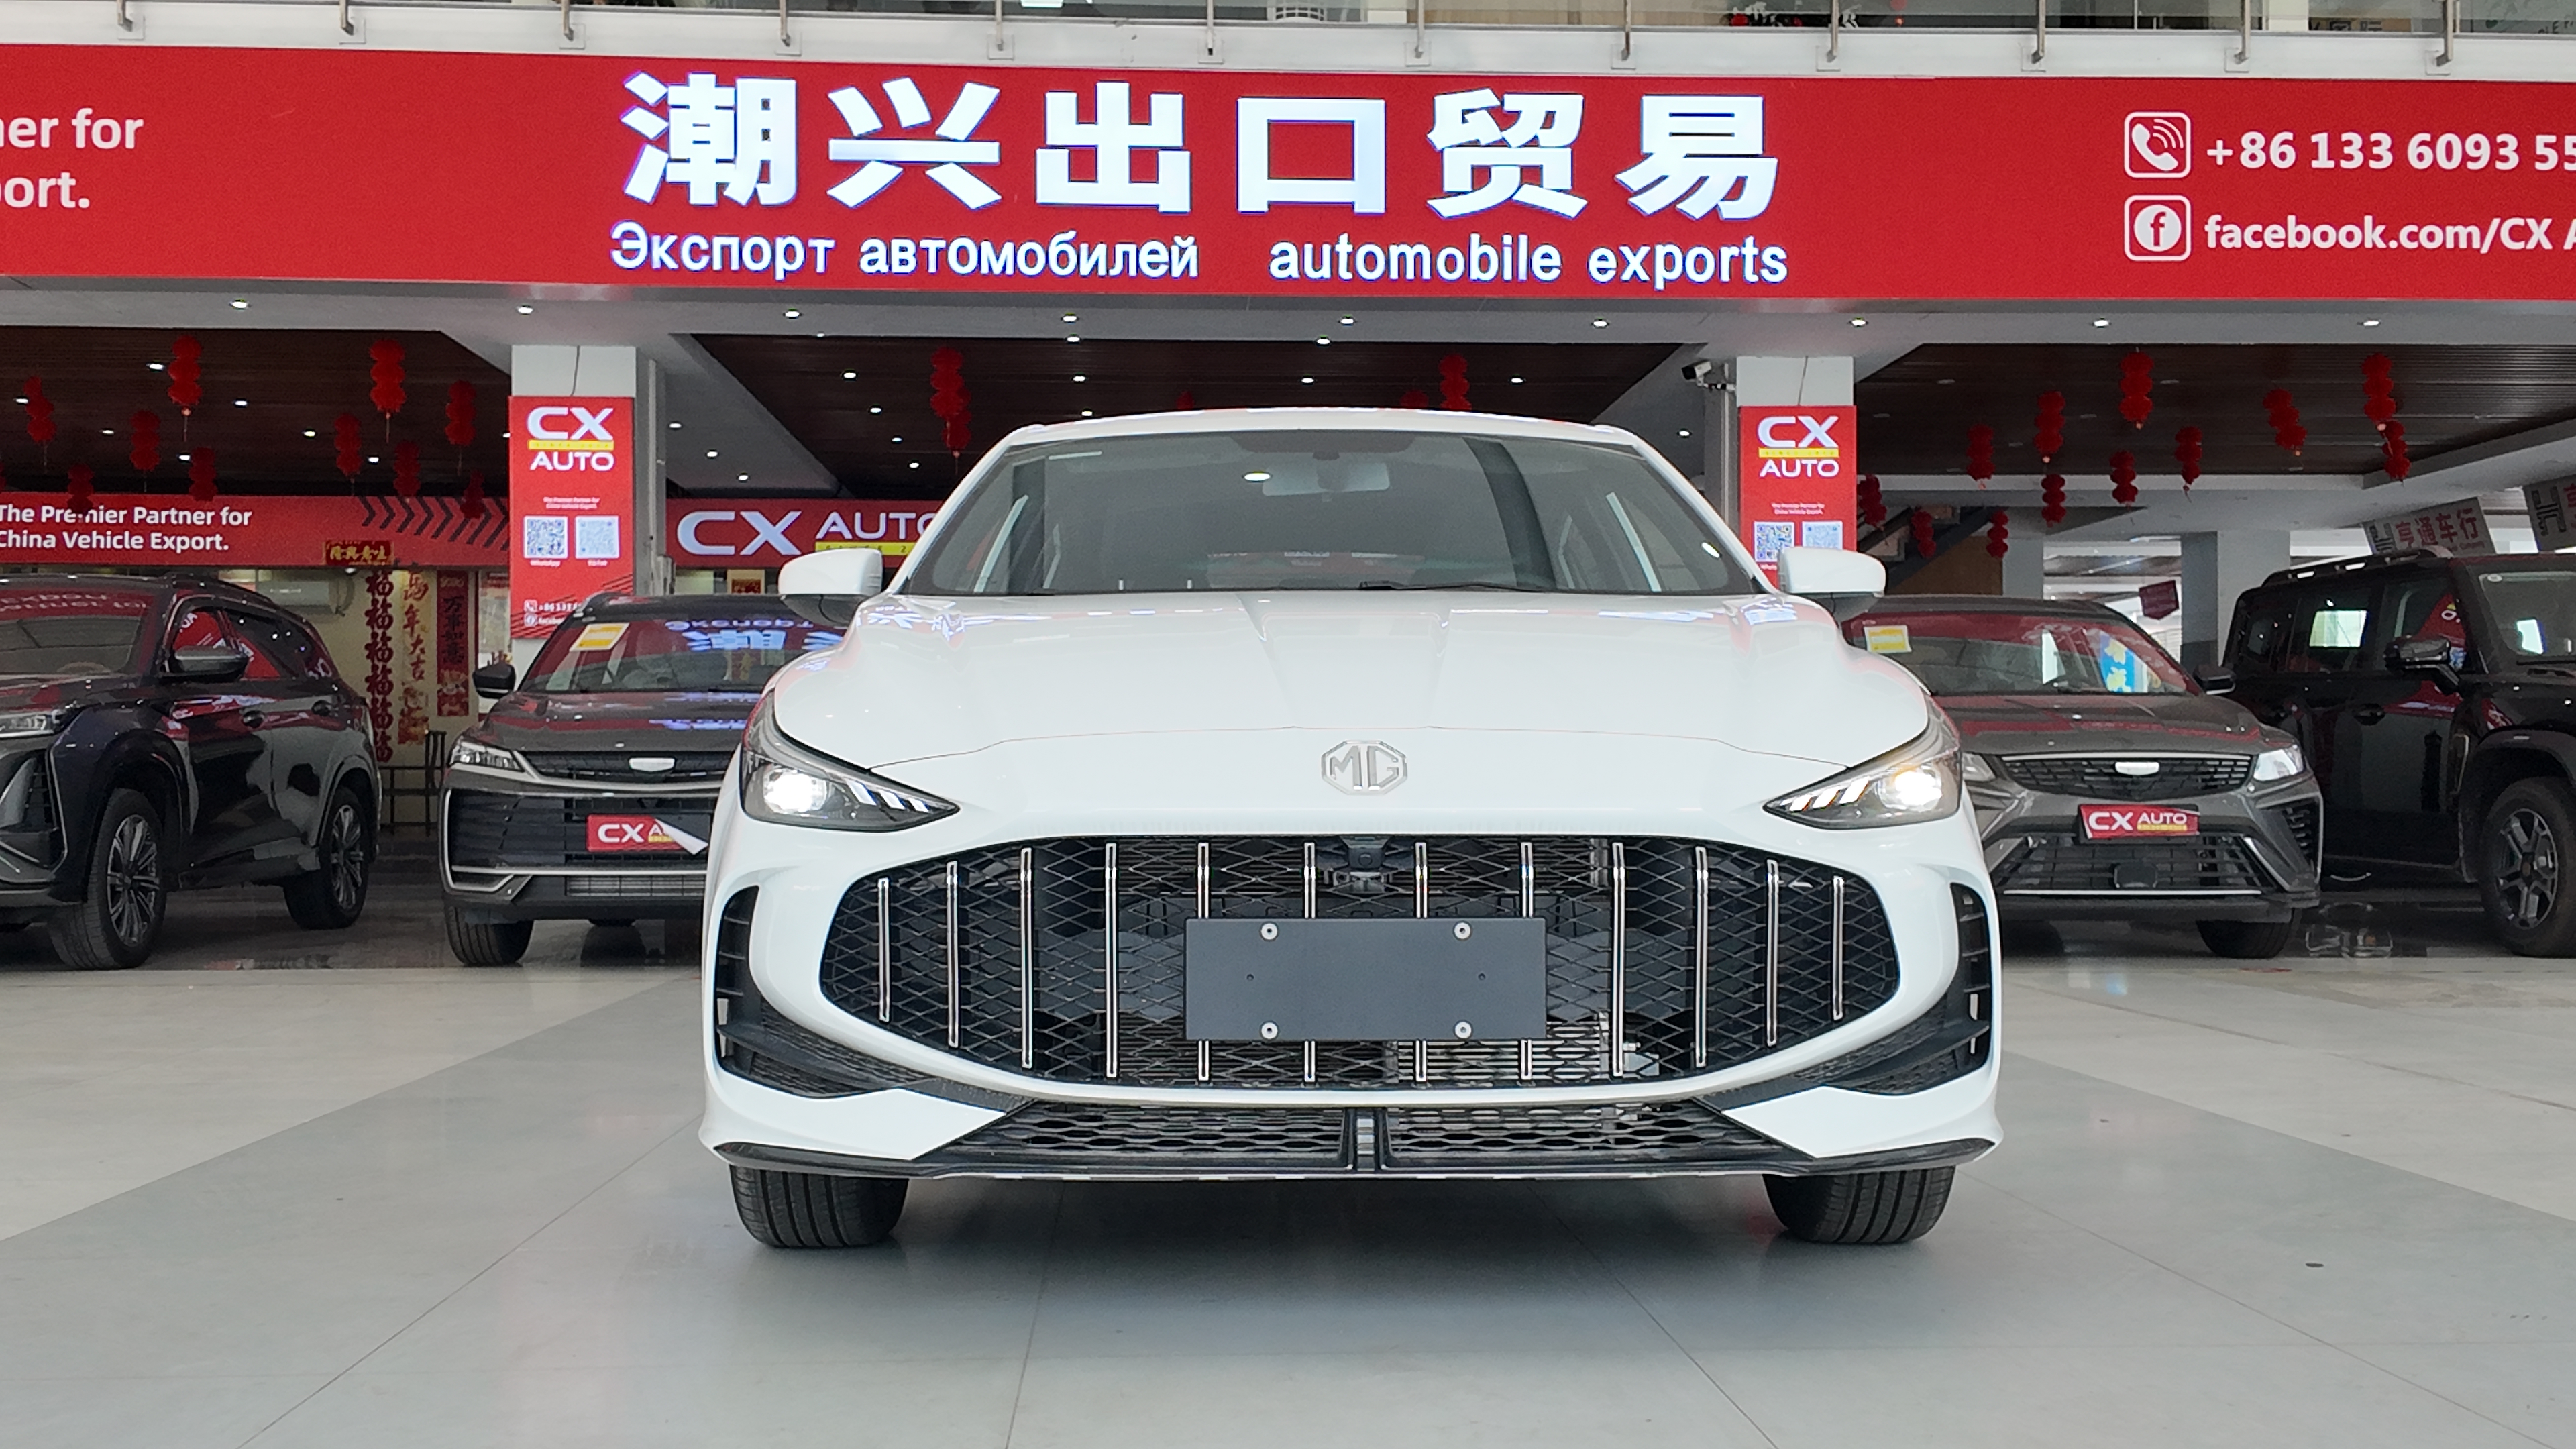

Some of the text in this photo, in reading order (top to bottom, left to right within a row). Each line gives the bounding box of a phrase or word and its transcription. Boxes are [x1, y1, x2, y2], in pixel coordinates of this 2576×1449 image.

[0, 107, 144, 149] er for
[621, 72, 1779, 220] 潮兴出口贸易
[2206, 131, 2296, 169] +86
[2310, 132, 2393, 169] 133
[2407, 133, 2519, 170] 6093
[0, 172, 90, 209] ort.
[610, 220, 1199, 281] Экспорт автомобилей
[1269, 233, 1788, 290] automobile exports
[526, 406, 614, 440] CX
[1757, 415, 1839, 448] CX
[529, 451, 615, 472] AUTO
[1759, 458, 1840, 478] AUTO
[0, 503, 35, 523] The
[133, 507, 215, 525] Partner
[219, 507, 252, 525] for
[0, 529, 229, 554] China Vehicle Export.
[676, 510, 802, 556] CX
[1329, 745, 1400, 790] MG
[598, 823, 645, 843] CX
[2088, 811, 2134, 831] CX
[2137, 812, 2188, 824] AUTO
